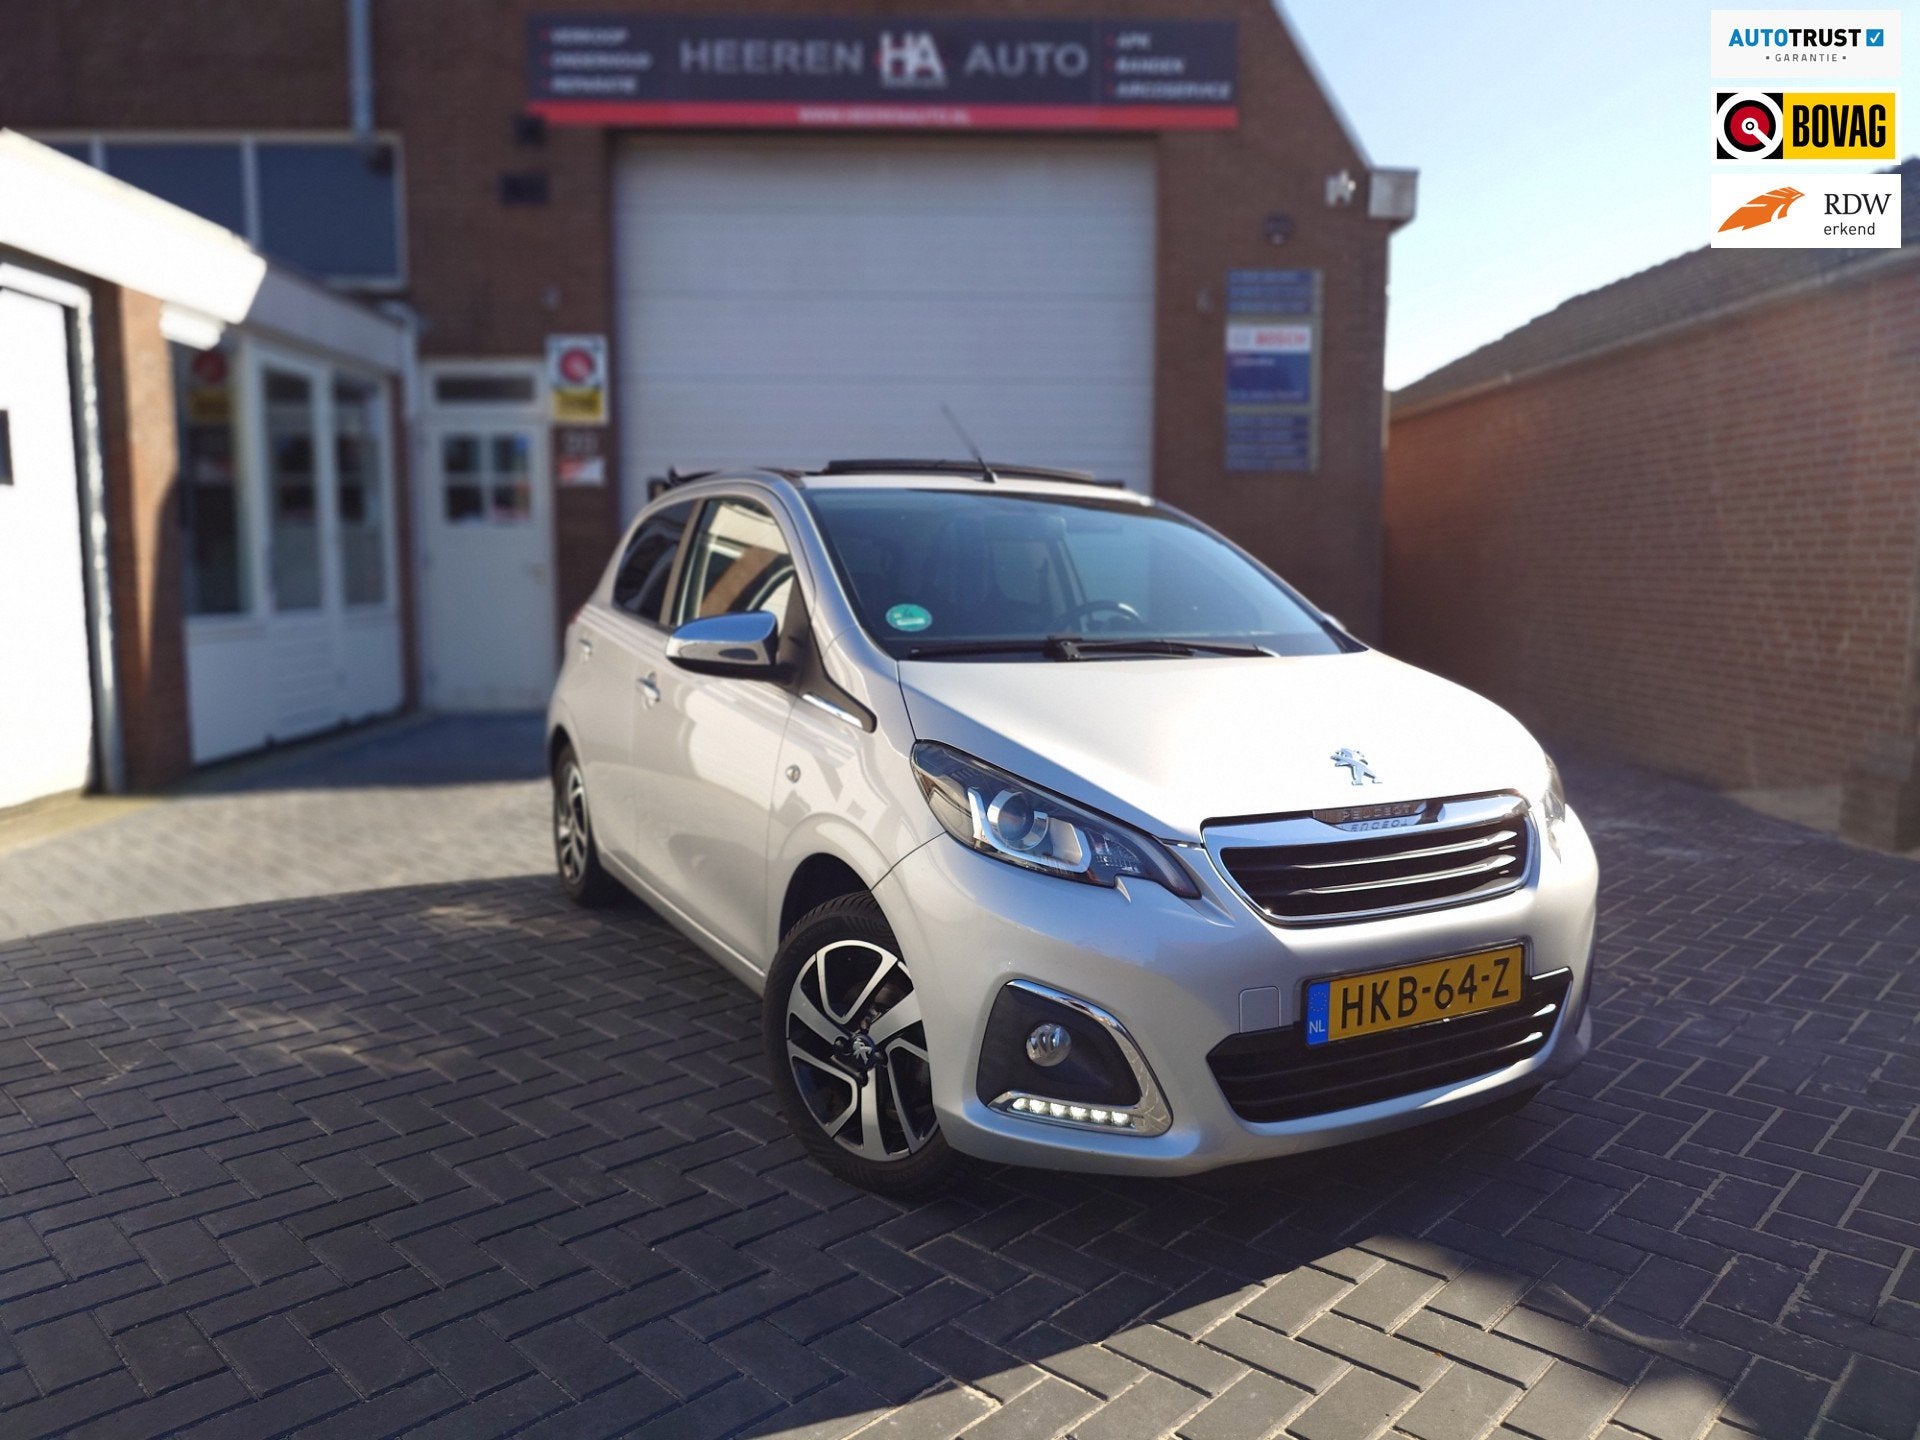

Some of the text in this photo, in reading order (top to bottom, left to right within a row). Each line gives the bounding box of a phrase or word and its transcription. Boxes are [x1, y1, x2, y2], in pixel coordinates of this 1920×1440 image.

[679, 41, 865, 74] HEEREN
[964, 42, 1089, 76] AUTO
[1341, 957, 1511, 1029] HKB-64-Z
[1308, 1020, 1326, 1034] NL
